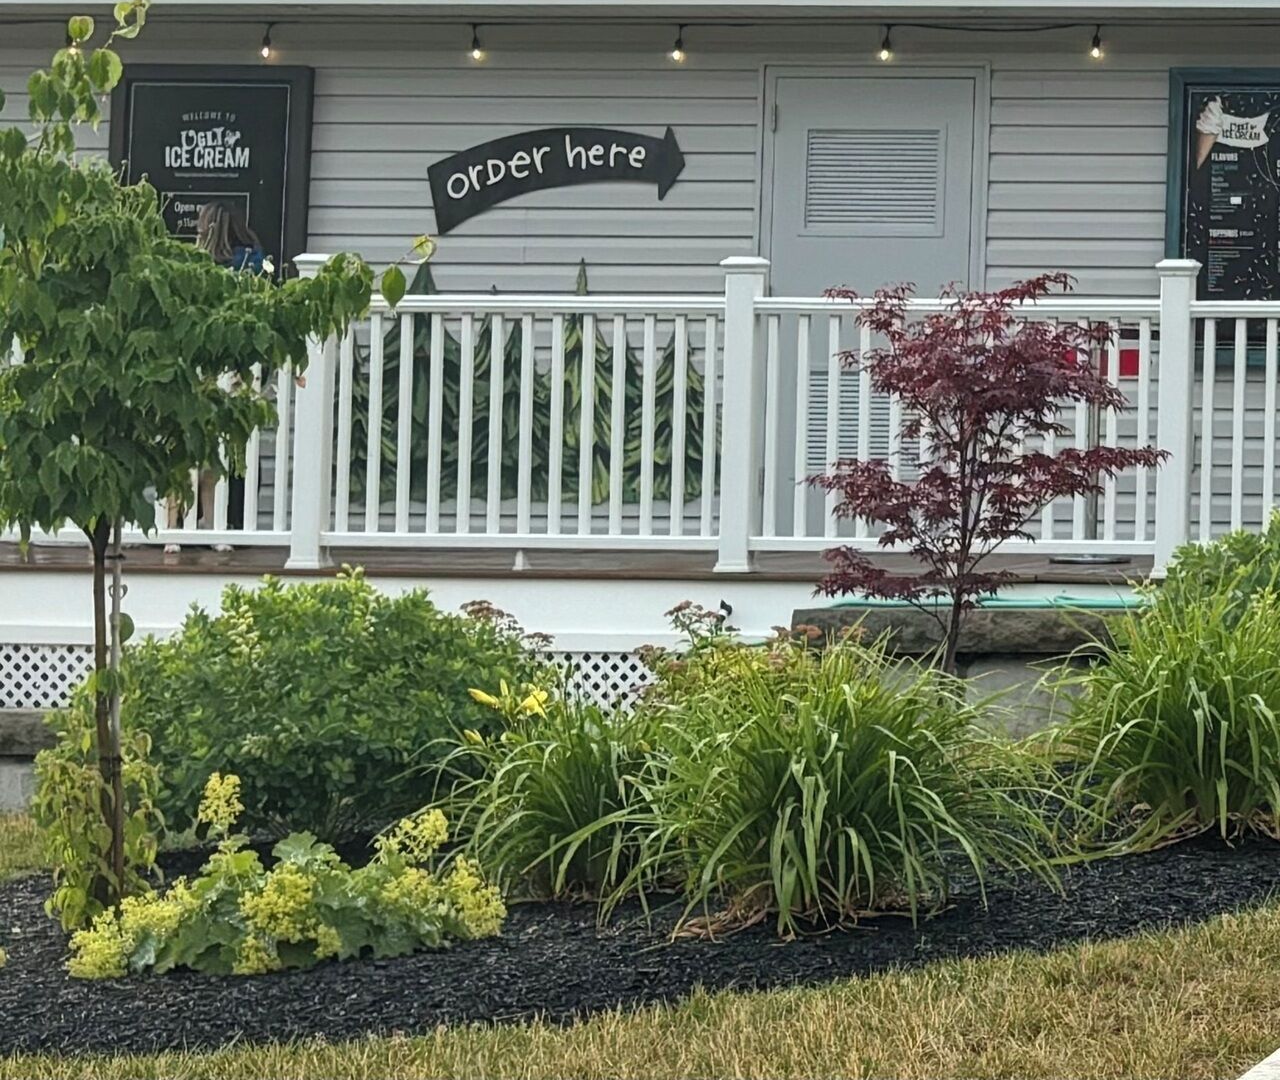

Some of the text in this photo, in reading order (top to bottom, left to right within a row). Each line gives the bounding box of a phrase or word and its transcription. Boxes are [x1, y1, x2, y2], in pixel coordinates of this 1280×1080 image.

[182, 111, 221, 122] WELCOME
[180, 126, 225, 151] UGLY
[165, 146, 250, 169] ICE CREAM
[565, 134, 646, 169] here
[174, 201, 195, 214] Open
